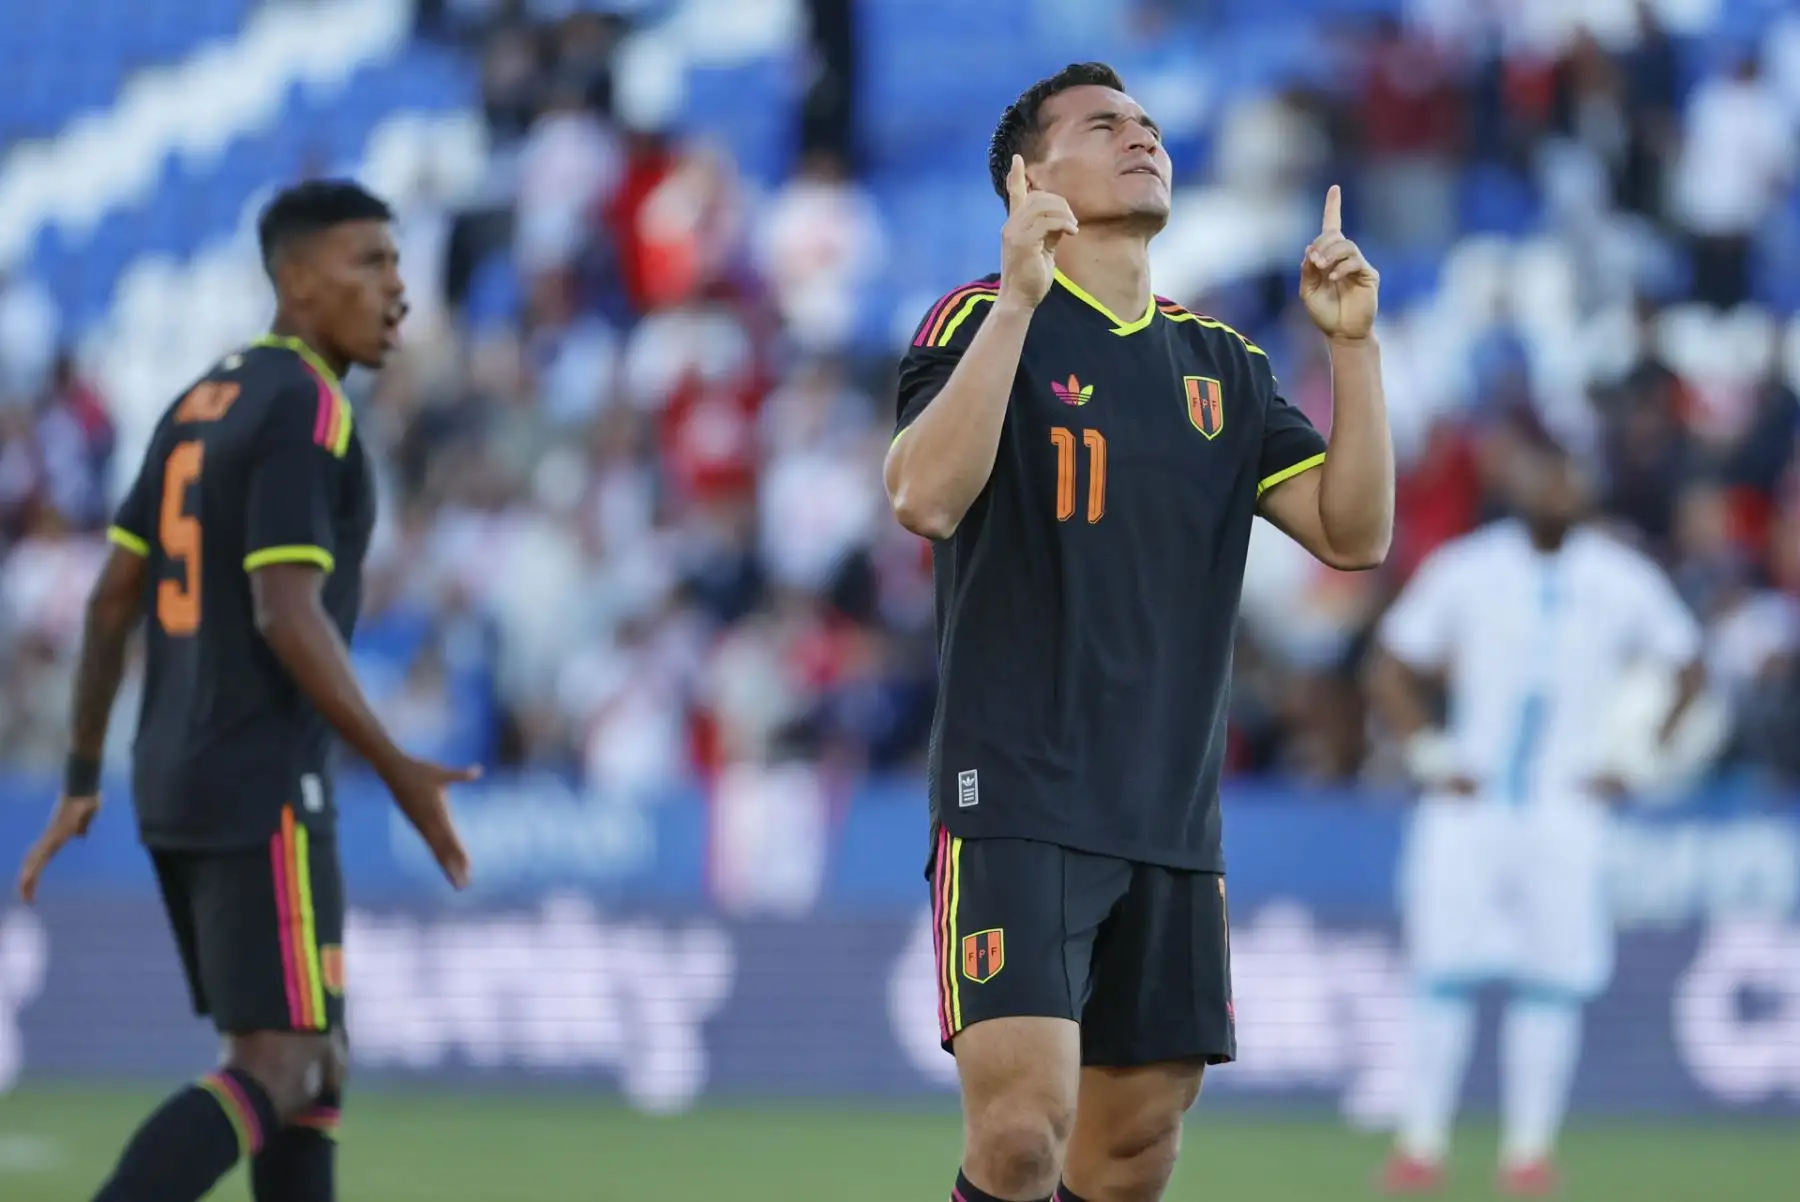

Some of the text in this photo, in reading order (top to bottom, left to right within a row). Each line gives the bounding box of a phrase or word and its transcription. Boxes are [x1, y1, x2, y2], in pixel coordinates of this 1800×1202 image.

[1192, 397, 1217, 410] FPF
[1050, 427, 1107, 525] 11
[157, 440, 204, 636] 5
[968, 946, 998, 962] FPF
